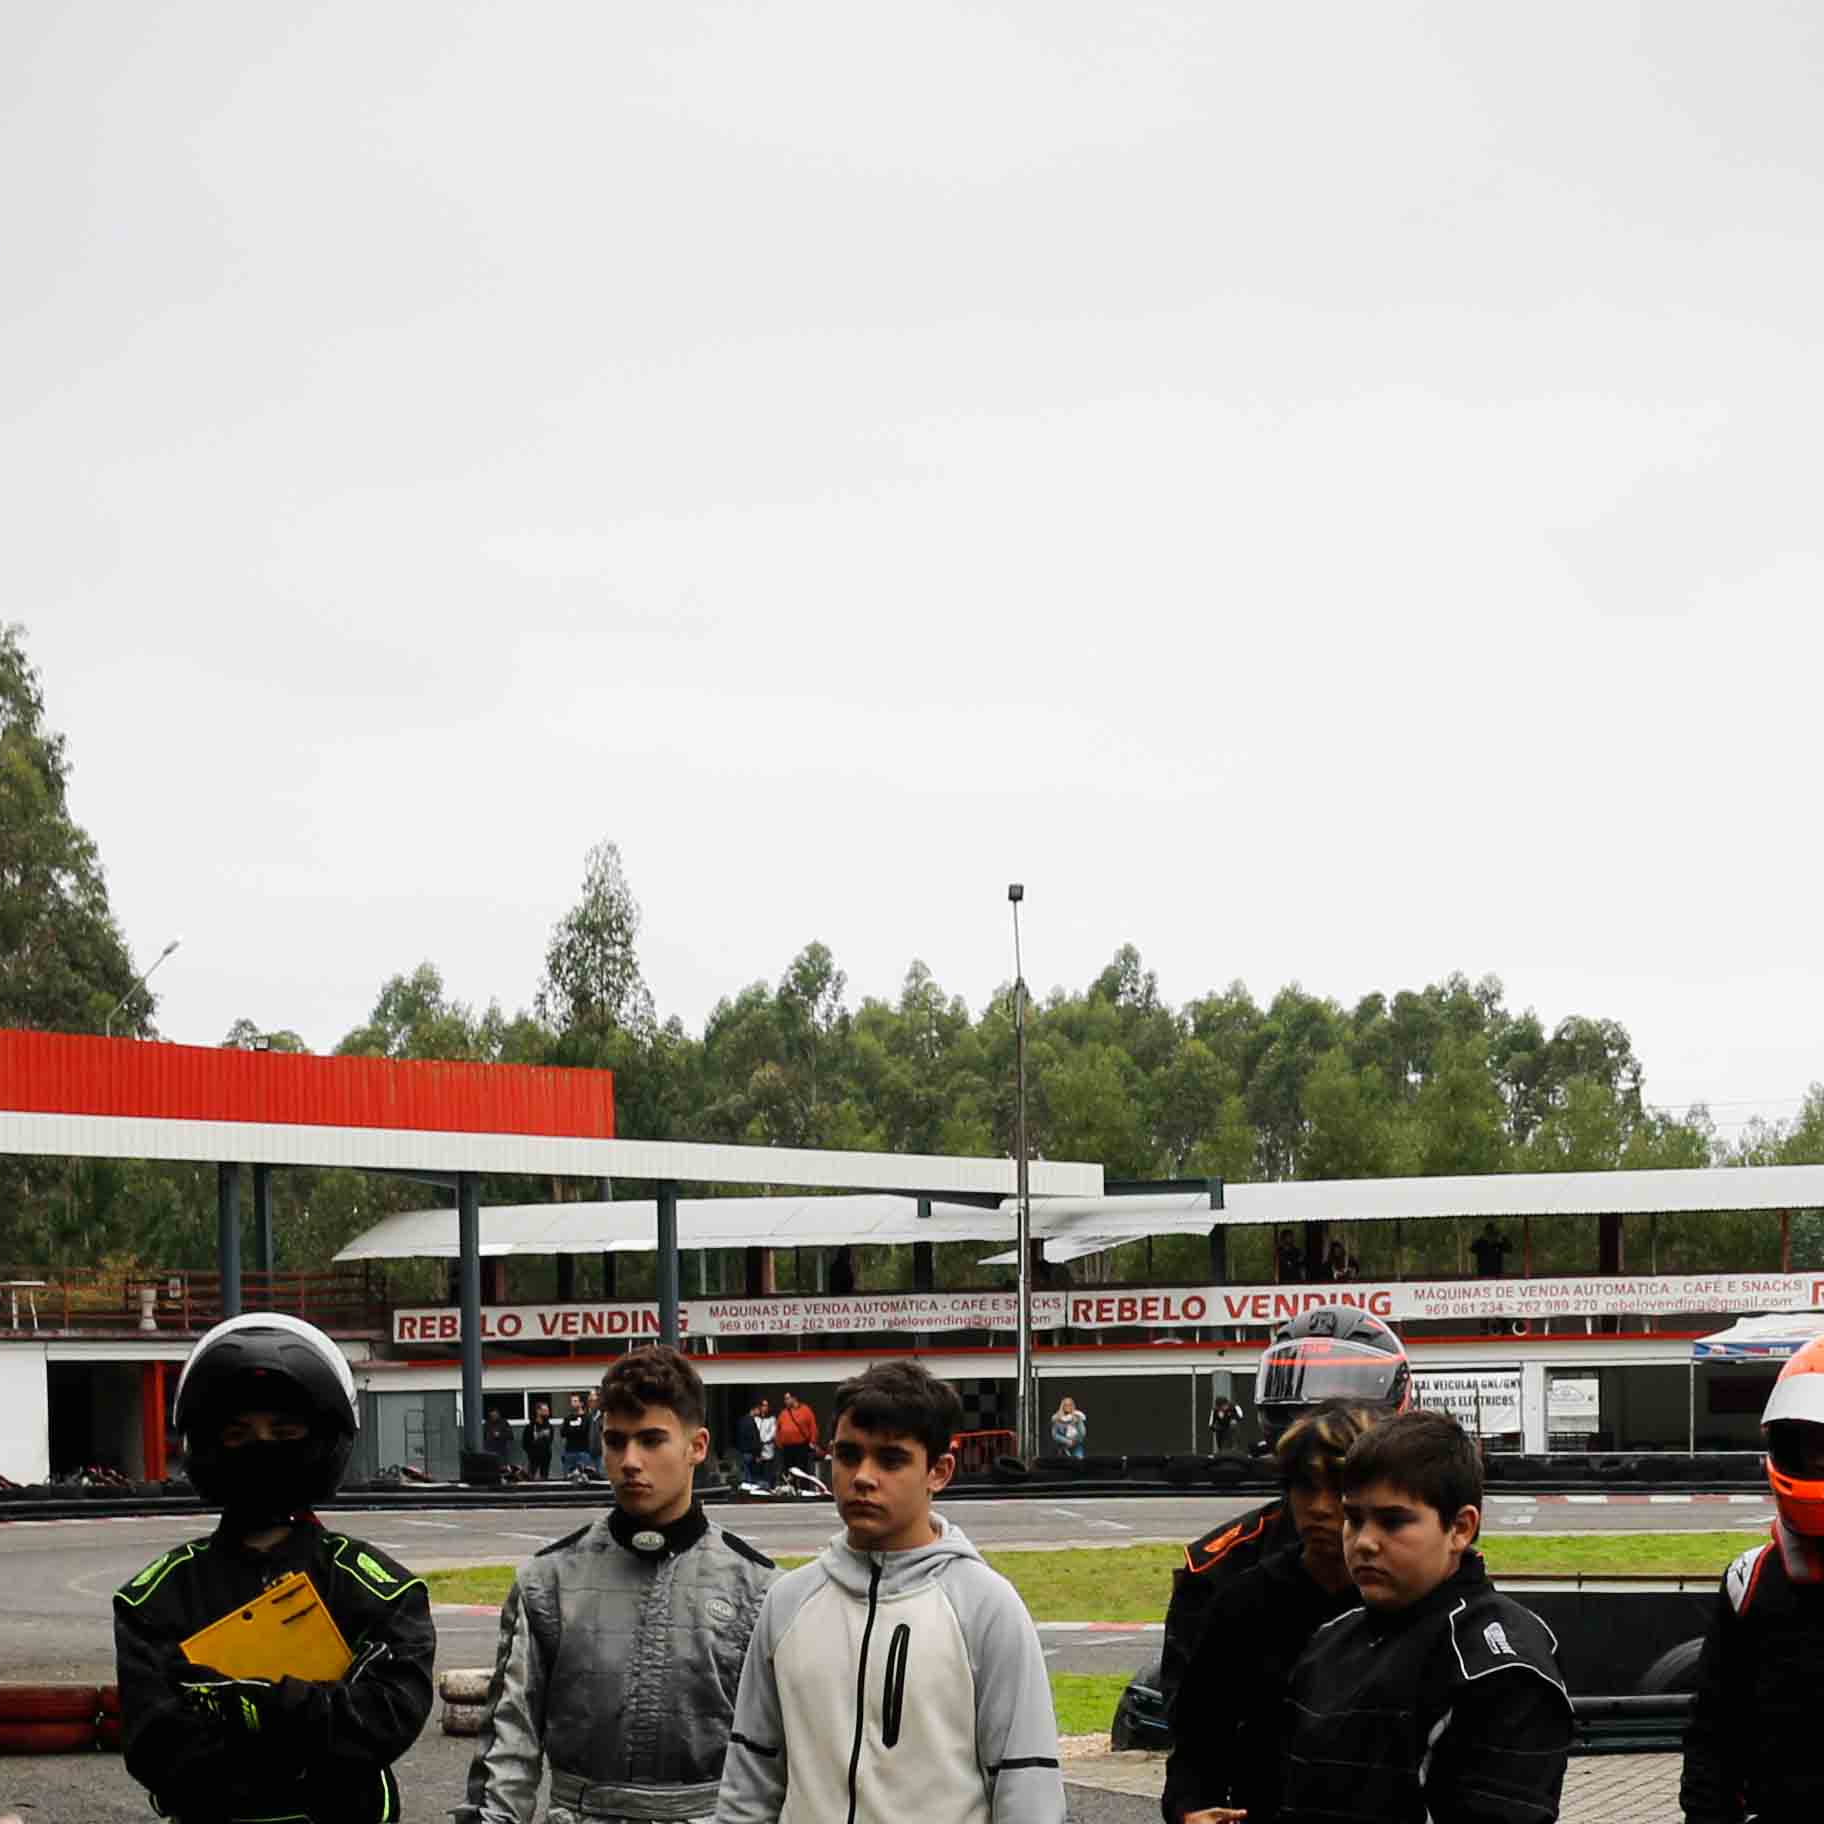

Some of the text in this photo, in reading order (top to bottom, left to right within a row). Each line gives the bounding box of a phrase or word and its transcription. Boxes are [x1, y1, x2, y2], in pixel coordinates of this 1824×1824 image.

[1496, 1286, 1514, 1298] DE
[1519, 1285, 1569, 1297] VENDA
[1683, 1281, 1722, 1294] CAFÉ
[1727, 1281, 1736, 1293] E
[1741, 1279, 1803, 1292] SNACKS
[783, 1304, 800, 1316] DE
[804, 1303, 850, 1315] VENDA
[991, 1299, 1001, 1311] E
[1007, 1297, 1062, 1311] SNCKS
[1072, 1291, 1392, 1323] REBELO VENDING
[398, 1313, 523, 1339] REBLO
